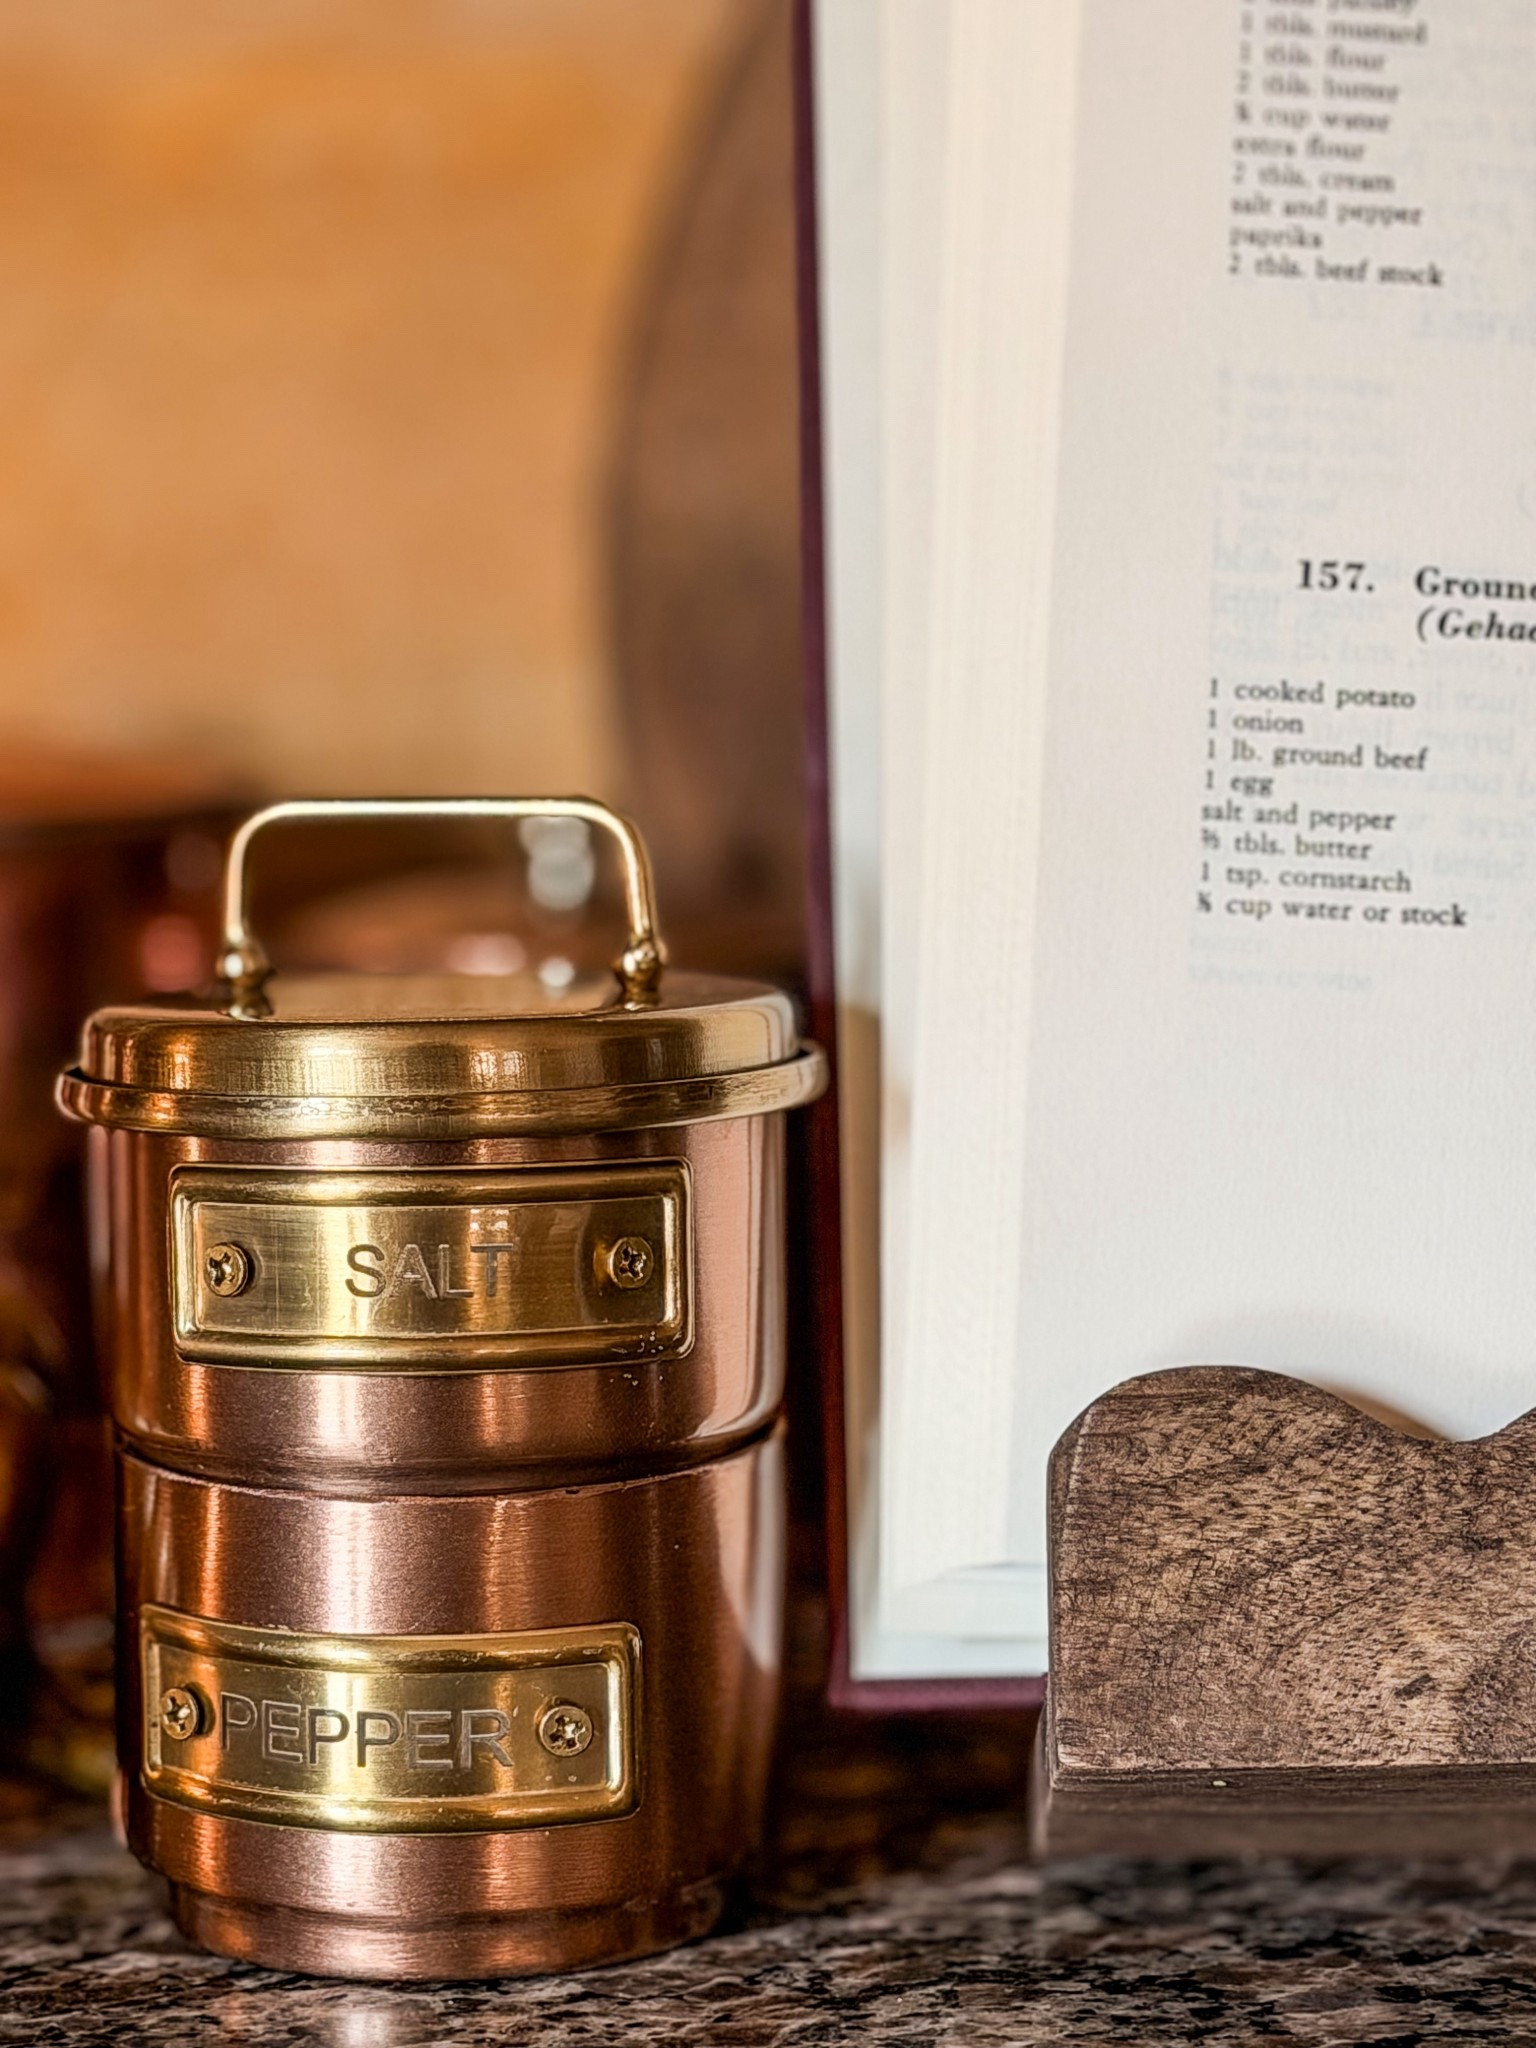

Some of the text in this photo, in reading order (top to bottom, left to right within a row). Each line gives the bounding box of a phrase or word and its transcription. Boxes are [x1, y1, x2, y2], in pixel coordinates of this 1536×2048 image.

[1319, 173, 1396, 193] cream
[1230, 193, 1423, 227] salt and pepper
[1229, 225, 1324, 250] paprika
[1228, 252, 1242, 276] 2
[1315, 257, 1369, 283] beef
[1377, 262, 1443, 288] stock
[1298, 559, 1374, 593] 157.
[1210, 677, 1219, 699] 1
[1233, 679, 1325, 705] cooked
[1335, 688, 1417, 711] potato
[1208, 708, 1305, 735] 1 onion
[1207, 737, 1429, 771] 1 lb. ground beef
[1205, 768, 1275, 798] 1 egg
[1201, 798, 1397, 834] salt and pepper
[1233, 831, 1286, 856] tbls.
[1294, 831, 1373, 861] butter
[1201, 860, 1412, 894] 1 tsp. cornstarch
[1224, 898, 1273, 922] cup
[1282, 901, 1353, 921] water
[1362, 906, 1391, 924] or
[1400, 902, 1467, 928] stock
[345, 1242, 514, 1301] SALT
[219, 1691, 515, 1769] PEPPER
